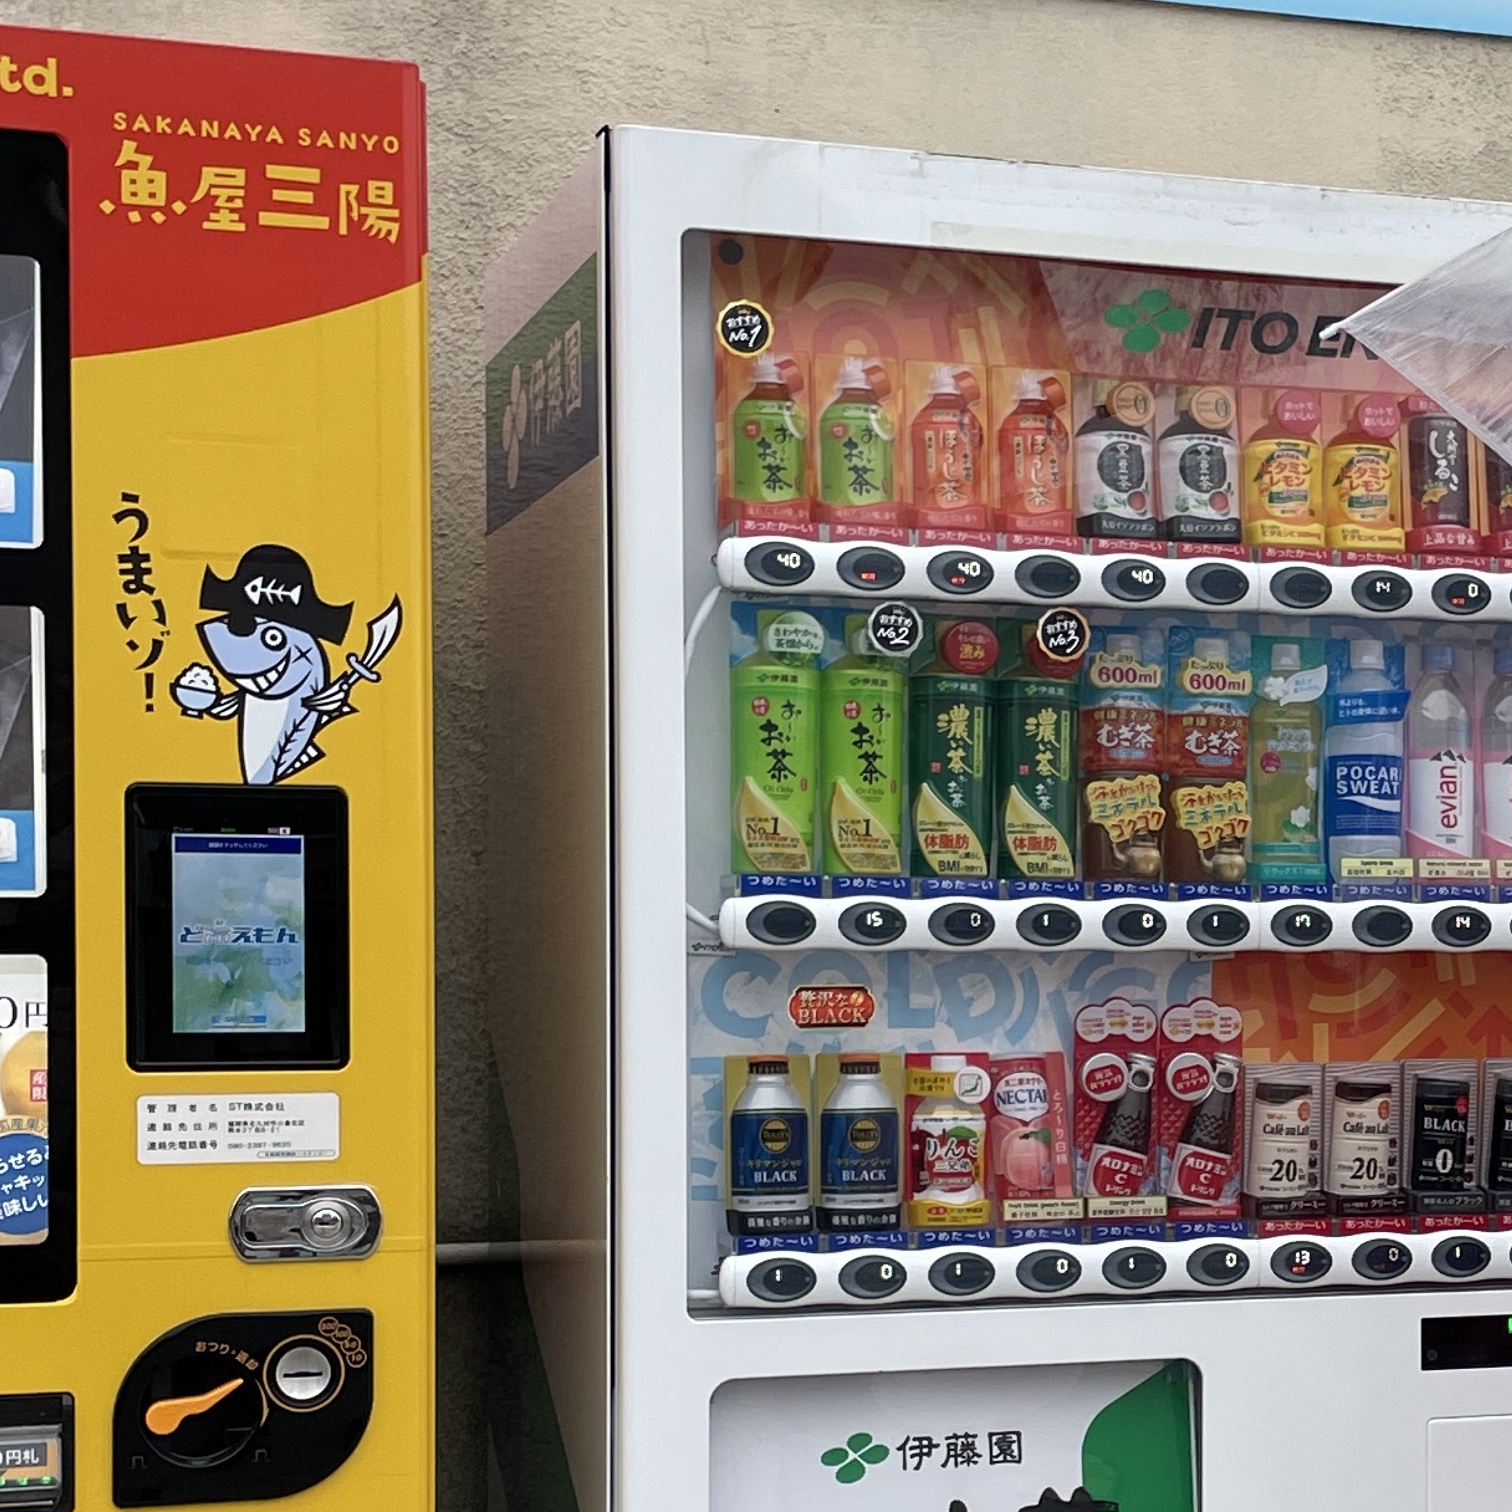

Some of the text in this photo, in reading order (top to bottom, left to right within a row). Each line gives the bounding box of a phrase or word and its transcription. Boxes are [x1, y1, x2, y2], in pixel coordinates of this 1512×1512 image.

[112, 109, 400, 156] SAKANAYA SANYO
[100, 138, 401, 247] 魚屋三陽
[729, 325, 762, 348] No.1
[1191, 306, 1299, 355] ITO
[1429, 430, 1459, 491] しるこ
[877, 627, 910, 646] No.2
[1097, 667, 1158, 685] 600ml
[1189, 673, 1246, 691] 600ml
[936, 703, 974, 774] 濃い茶
[1024, 707, 1061, 777] 濃い茶
[1096, 723, 1156, 749] むぎ茶
[1184, 729, 1241, 756] むぎ茶
[759, 718, 797, 784] お茶
[850, 720, 888, 785] お茶
[1336, 780, 1400, 795] SWEAT
[1435, 765, 1458, 829] evian
[1111, 810, 1163, 839] ゴクゴク
[1198, 817, 1250, 845] ゴクゴク
[923, 834, 970, 850] 体脂肪
[1012, 836, 1058, 852] 体脂肪
[748, 876, 816, 887] つめた〜い
[838, 877, 906, 889] つめた〜い
[928, 879, 994, 890] つめた〜い
[1015, 880, 1081, 892] つめた〜い
[1100, 883, 1164, 894] つめた〜い
[1184, 884, 1246, 896] つめた〜い
[1266, 885, 1328, 895] つめた〜い
[1347, 886, 1408, 896] つめた〜い
[1426, 886, 1486, 896] つめた〜い
[797, 1007, 866, 1031] BLACK
[1423, 1116, 1466, 1133] BLACK
[1350, 1157, 1377, 1180] 20
[1435, 1148, 1454, 1174] 0
[754, 1170, 798, 1183] BLACK
[842, 1169, 887, 1182] BLACK
[1114, 1173, 1128, 1184] C
[1199, 1173, 1212, 1184] C
[1269, 1159, 1298, 1182] 20
[924, 1230, 991, 1242] つめた〜い
[1011, 1227, 1077, 1240] つめた〜い
[1097, 1225, 1160, 1237] つめた〜い
[1181, 1222, 1243, 1234] つめた〜い
[744, 1235, 814, 1248] つめた〜い
[834, 1233, 903, 1245] つめた〜い
[896, 1431, 1022, 1472] 伊藤園
